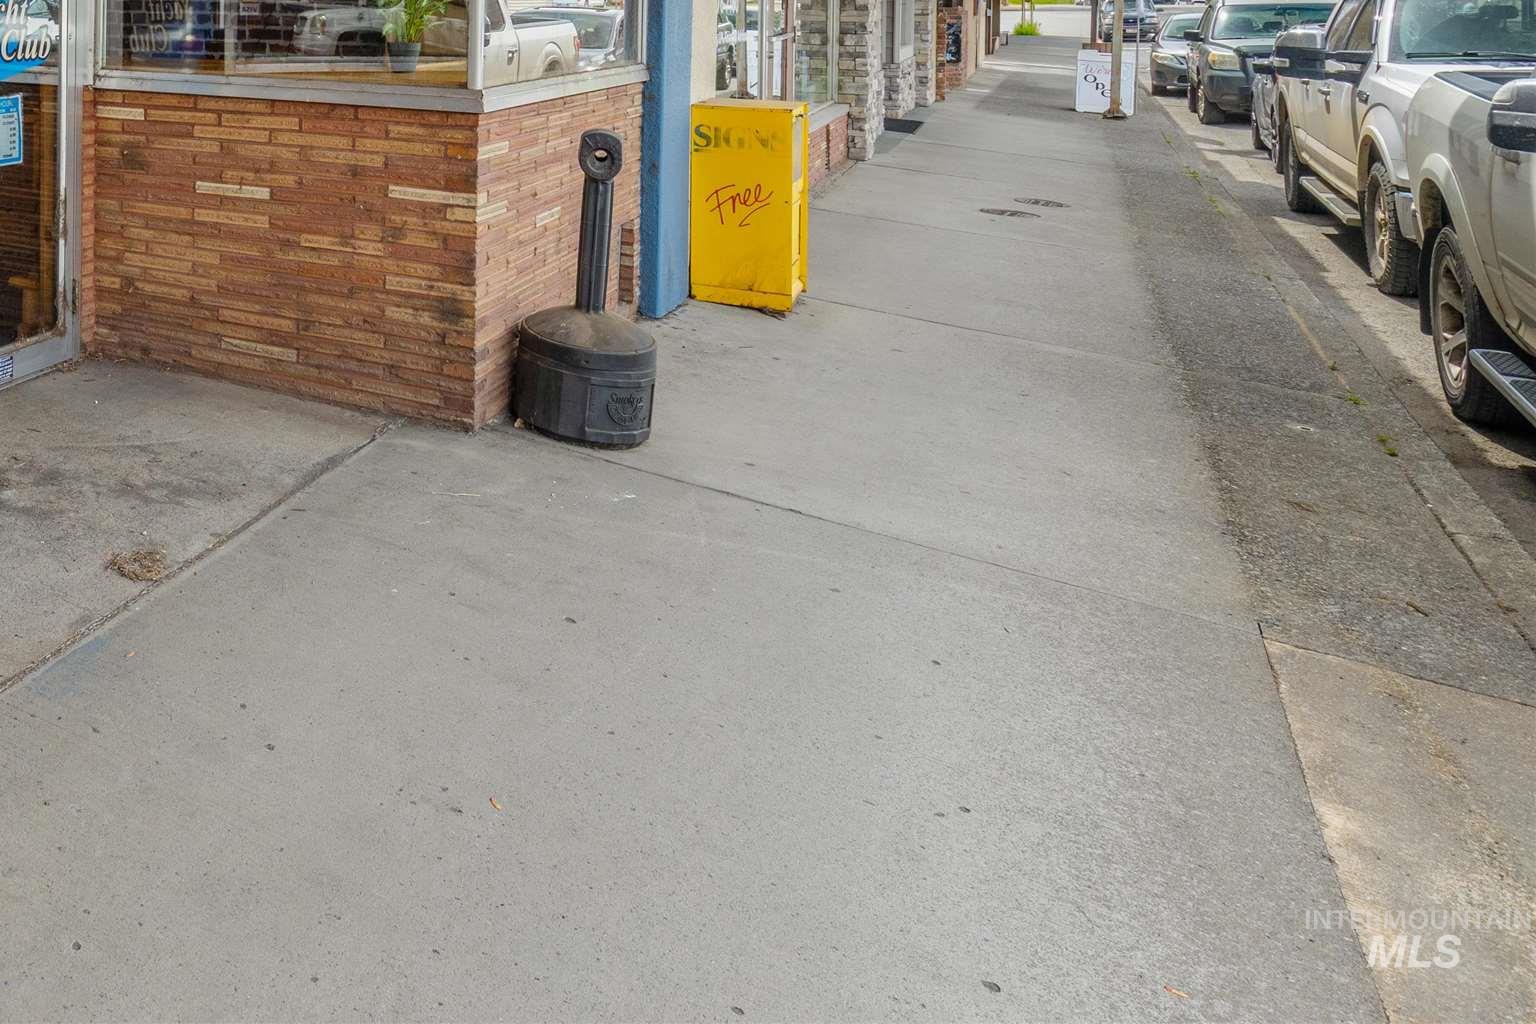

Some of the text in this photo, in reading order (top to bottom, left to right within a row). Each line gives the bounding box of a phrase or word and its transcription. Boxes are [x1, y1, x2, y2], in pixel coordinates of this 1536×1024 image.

[0, 28, 52, 62] Club
[1083, 73, 1112, 97] Ope
[705, 183, 774, 225] Free
